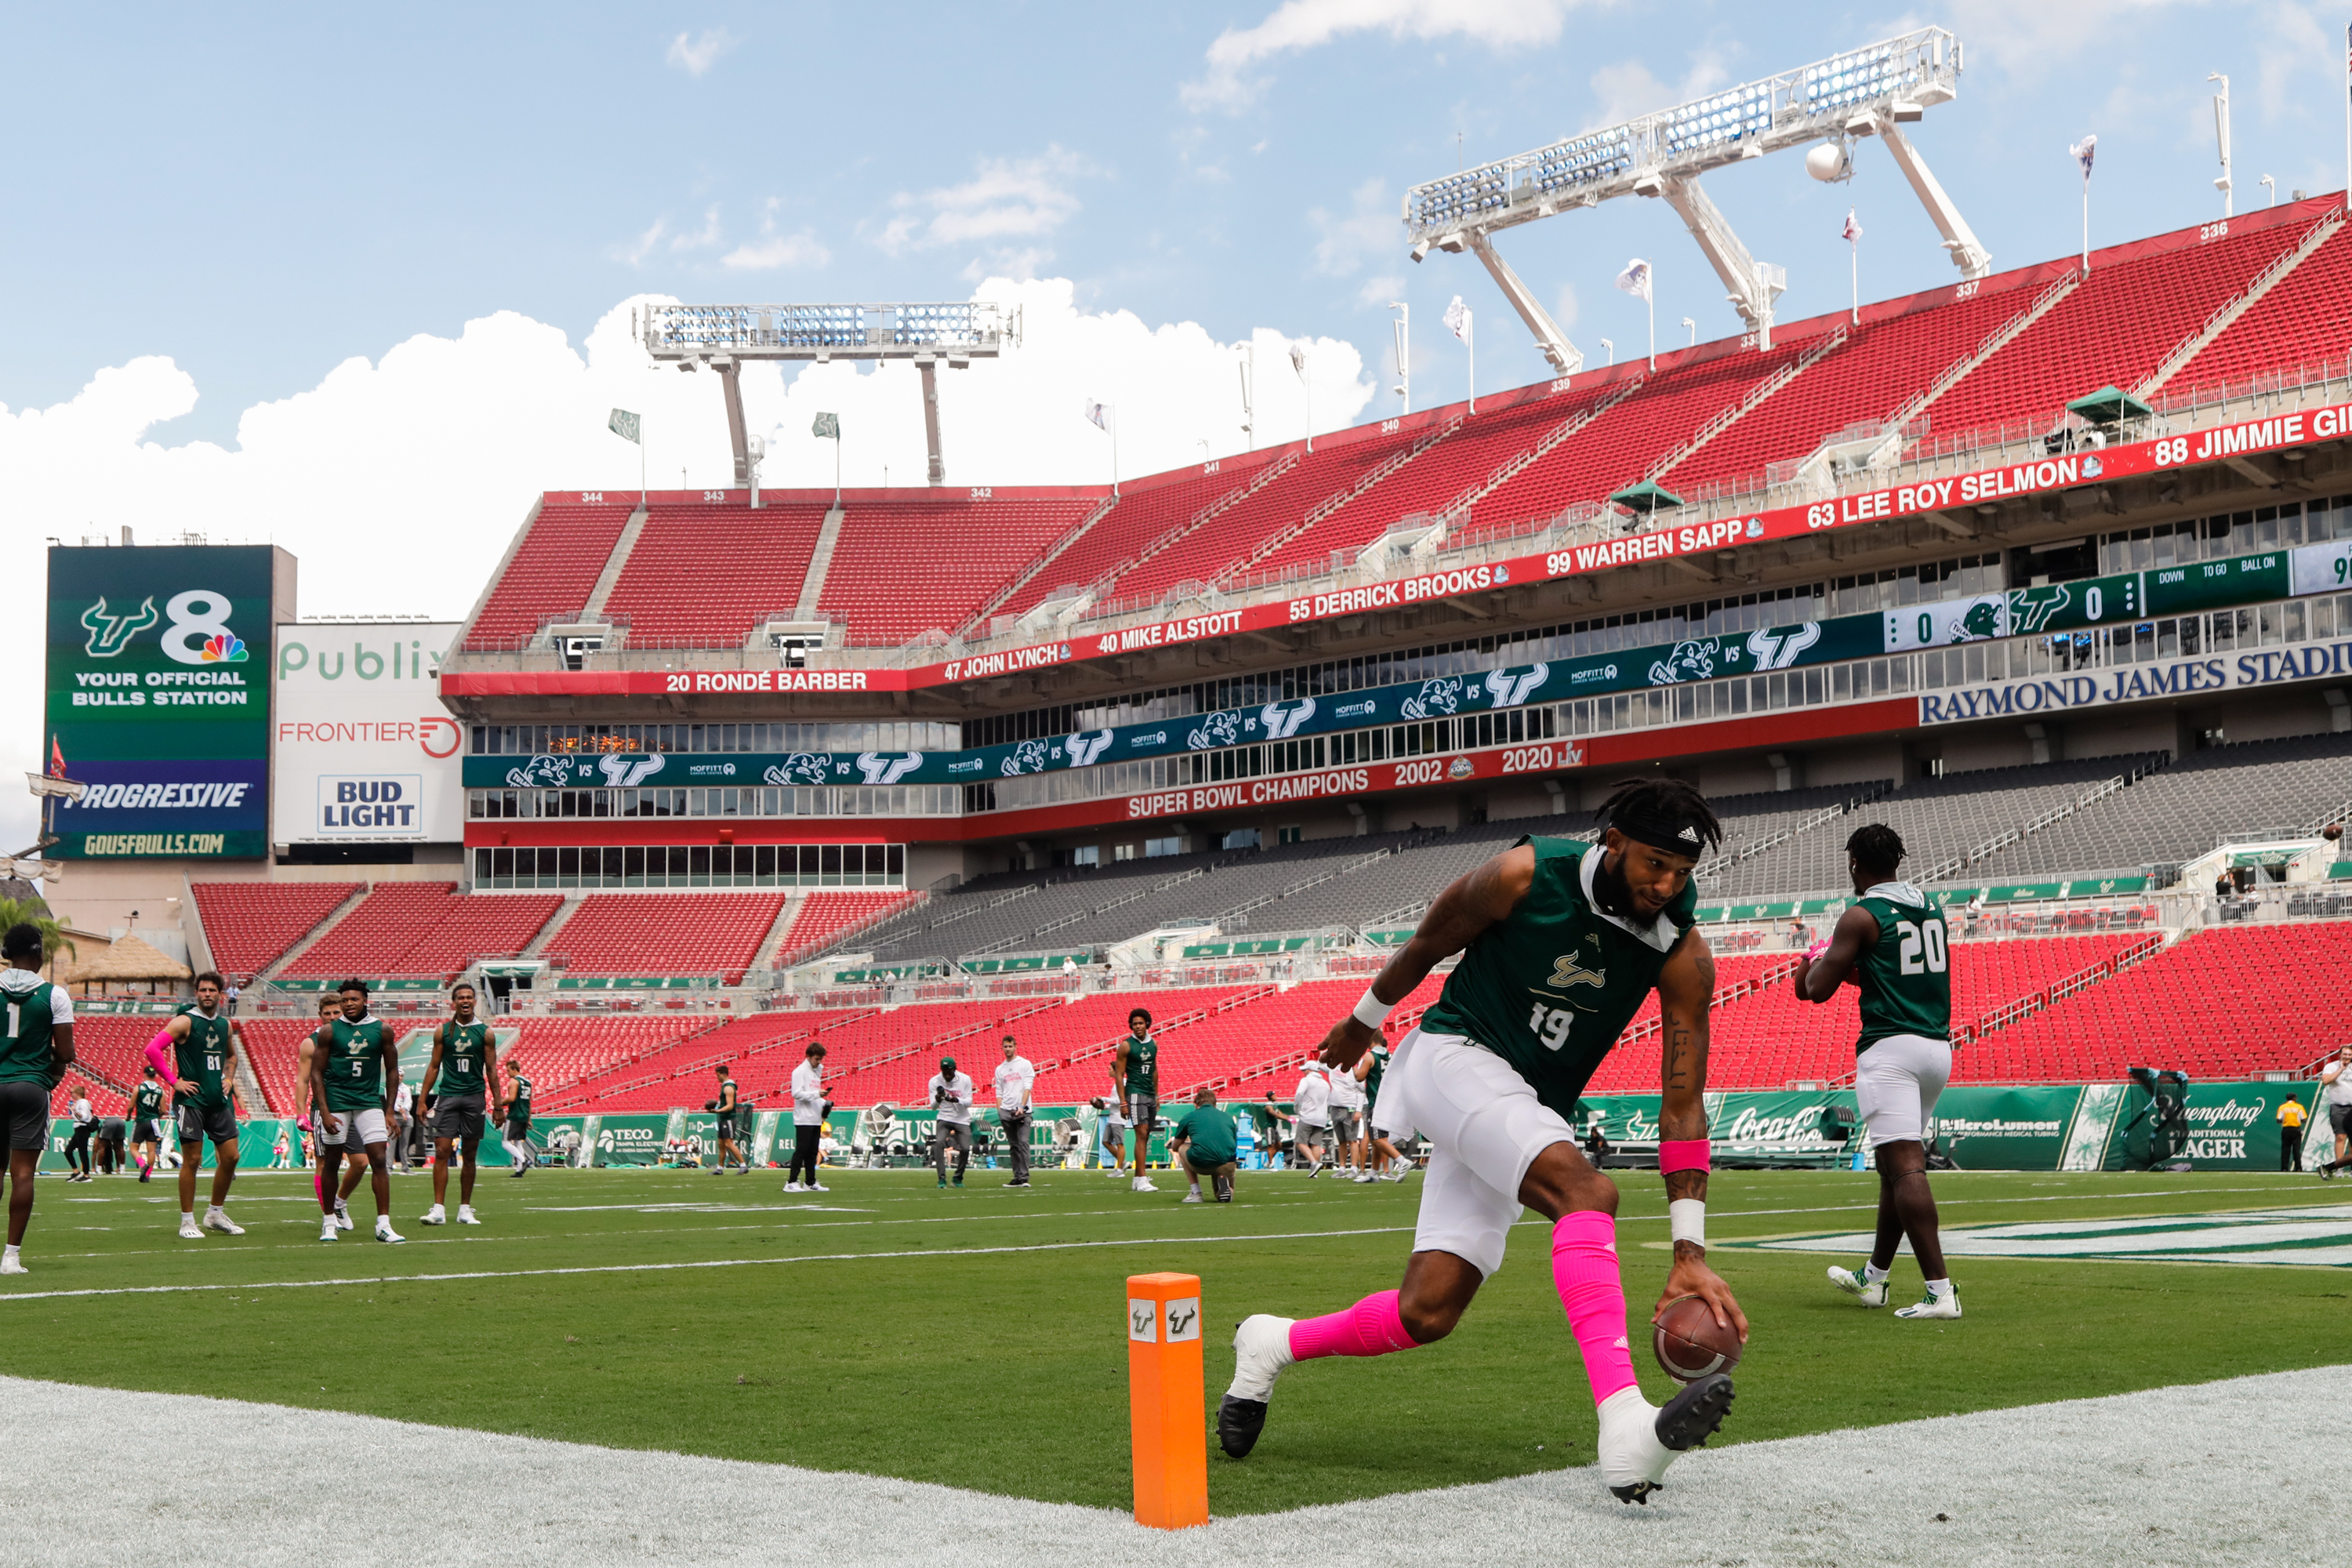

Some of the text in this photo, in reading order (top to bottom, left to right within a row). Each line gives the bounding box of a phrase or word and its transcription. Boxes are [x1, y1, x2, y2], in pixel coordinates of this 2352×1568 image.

[2200, 221, 2228, 241] 336
[1956, 280, 1980, 298] 337
[1551, 378, 1570, 393] 339
[1381, 419, 1399, 433] 340
[2154, 405, 2352, 467] 88 JIMMIE GI
[1204, 461, 1221, 474] 341
[582, 492, 603, 502] 344
[704, 491, 724, 501] 343
[971, 488, 992, 498] 342
[1807, 459, 2077, 528] 63 LEE ROY SELMON
[1547, 521, 1743, 575] 99 WARREN SAPP
[2159, 556, 2275, 584] DOWN TO GO BALL ON
[2334, 557, 2352, 584] 9
[1290, 567, 1491, 621] 55 DERRICK BROOKS
[2086, 587, 2103, 620] 0
[161, 590, 234, 664] 8
[1099, 610, 1243, 653] 40 MIKE ALSTOTT
[1918, 612, 1932, 644] 0
[944, 644, 1058, 681] 47 JOHN LYNCH
[1725, 646, 1740, 662] VS
[75, 672, 245, 687] YOUR OFFICIAL
[666, 670, 866, 692] 20 RONDÉ BARBER
[1572, 668, 1604, 680] MOFFITT
[1921, 642, 2352, 724] RAYMOND JAMES STADI
[73, 691, 247, 706] BULLS STATION
[1467, 684, 1479, 699] VS
[1336, 703, 1363, 714] MOFFITT
[279, 722, 415, 742] FRONTIER
[1245, 717, 1256, 731] VS
[1131, 734, 1156, 744] MOFFITT
[1051, 746, 1061, 760] VS
[1502, 746, 1552, 772] 2020
[579, 764, 592, 777] VS
[837, 762, 850, 774] VS
[64, 782, 249, 808] PROGRESSIVE
[337, 782, 401, 803] BUD
[1128, 760, 1442, 818] SUPER BOWL CHAMPIONS 2002
[324, 804, 414, 828] LIGHT
[85, 833, 224, 855] GOUSFBULLS.COM
[1678, 833, 1699, 843] adidas
[1896, 918, 1947, 975] 20
[7, 1002, 20, 1037] 1
[1530, 1002, 1574, 1051] 19
[206, 1055, 220, 1070] 81
[352, 1062, 361, 1076] 5
[456, 1058, 469, 1073] 10
[614, 1129, 653, 1140] TECO
[1940, 1119, 2060, 1131] MicroLumen
[2169, 1139, 2247, 1159] LAGER
